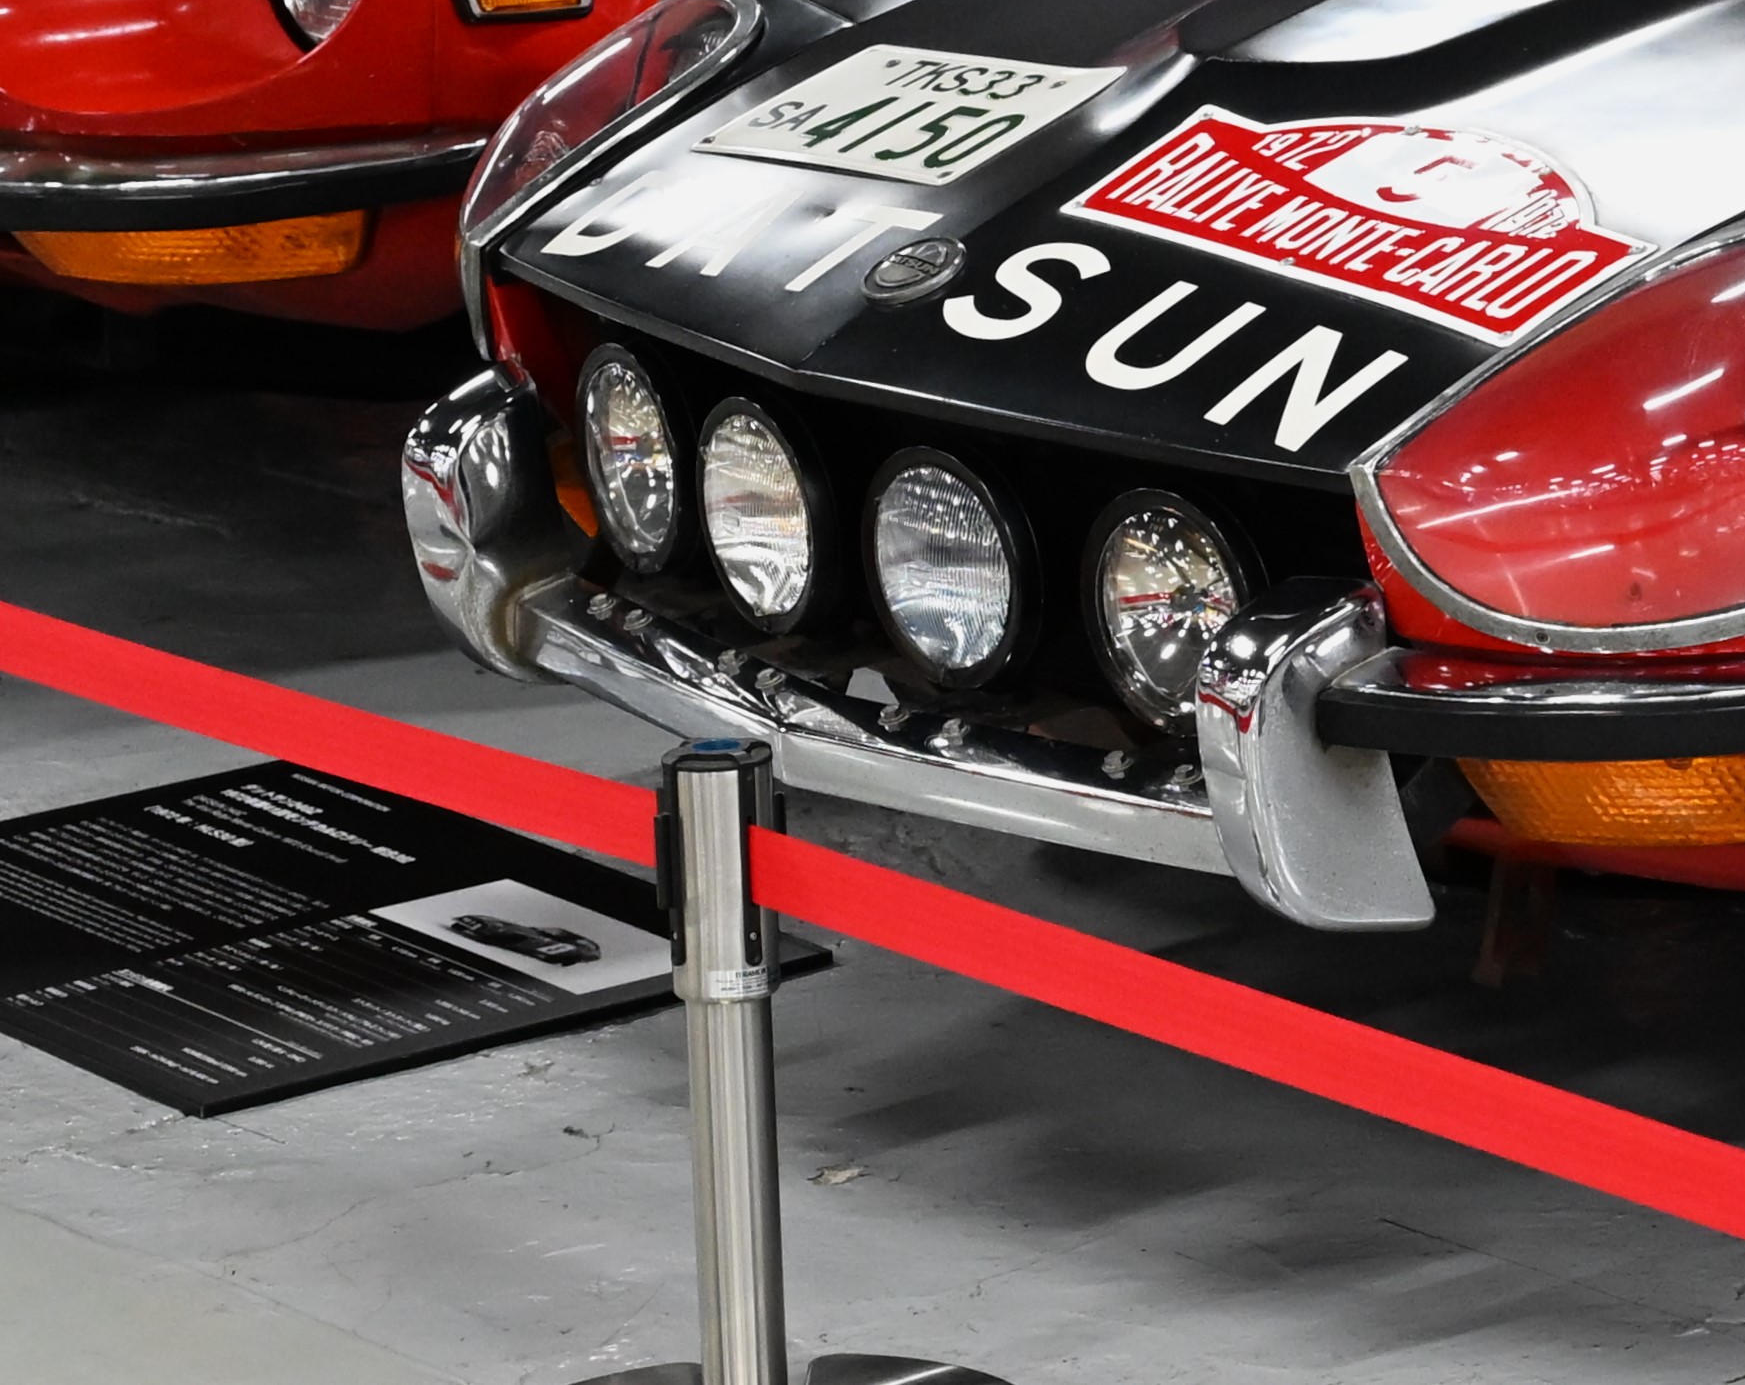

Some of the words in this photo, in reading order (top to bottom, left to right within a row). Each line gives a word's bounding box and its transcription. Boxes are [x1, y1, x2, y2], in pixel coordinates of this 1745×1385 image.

[748, 100, 829, 133] SA
[801, 96, 1028, 170] 4150
[1105, 131, 1277, 231] RALLYE
[1255, 194, 1598, 319] MONTE-CARLO
